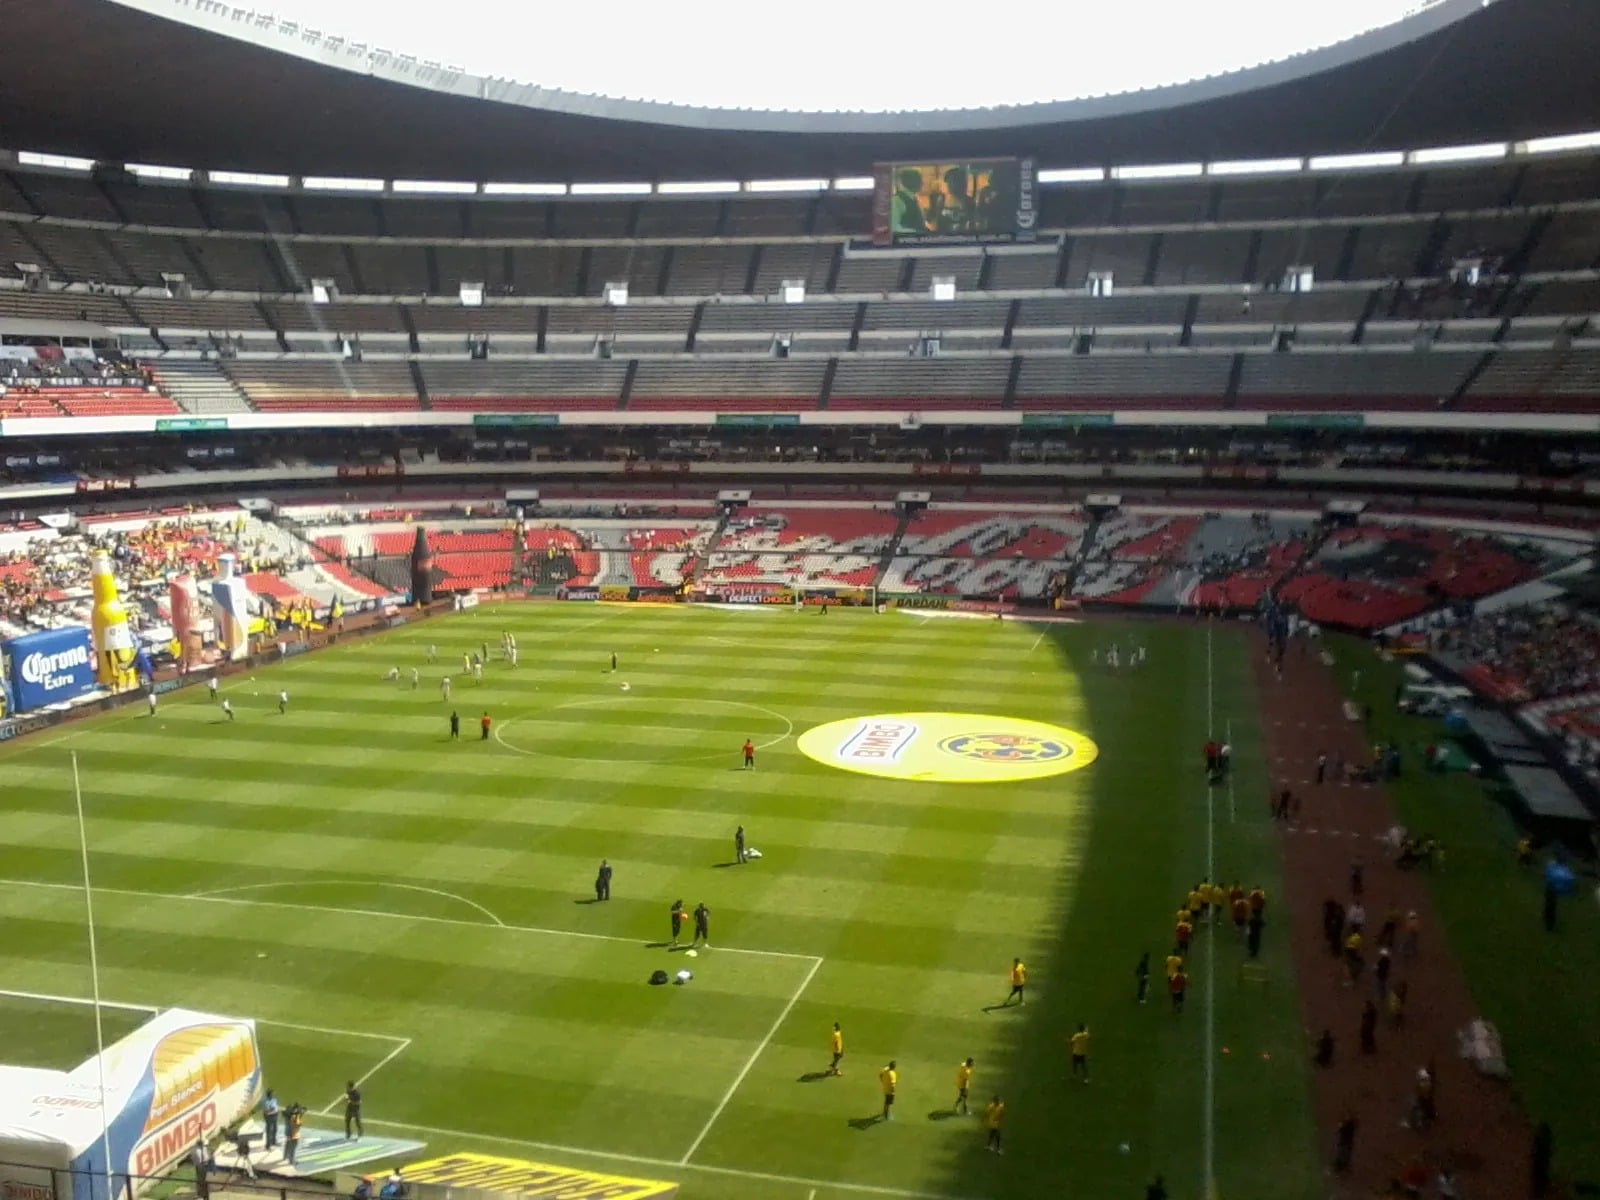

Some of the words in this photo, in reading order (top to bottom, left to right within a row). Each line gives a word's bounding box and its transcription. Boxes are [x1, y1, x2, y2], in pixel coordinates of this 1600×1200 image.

[1017, 160, 1038, 228] Corona
[22, 645, 87, 683] Corona
[44, 673, 74, 691] Extra
[135, 1102, 217, 1177] BIMBO
